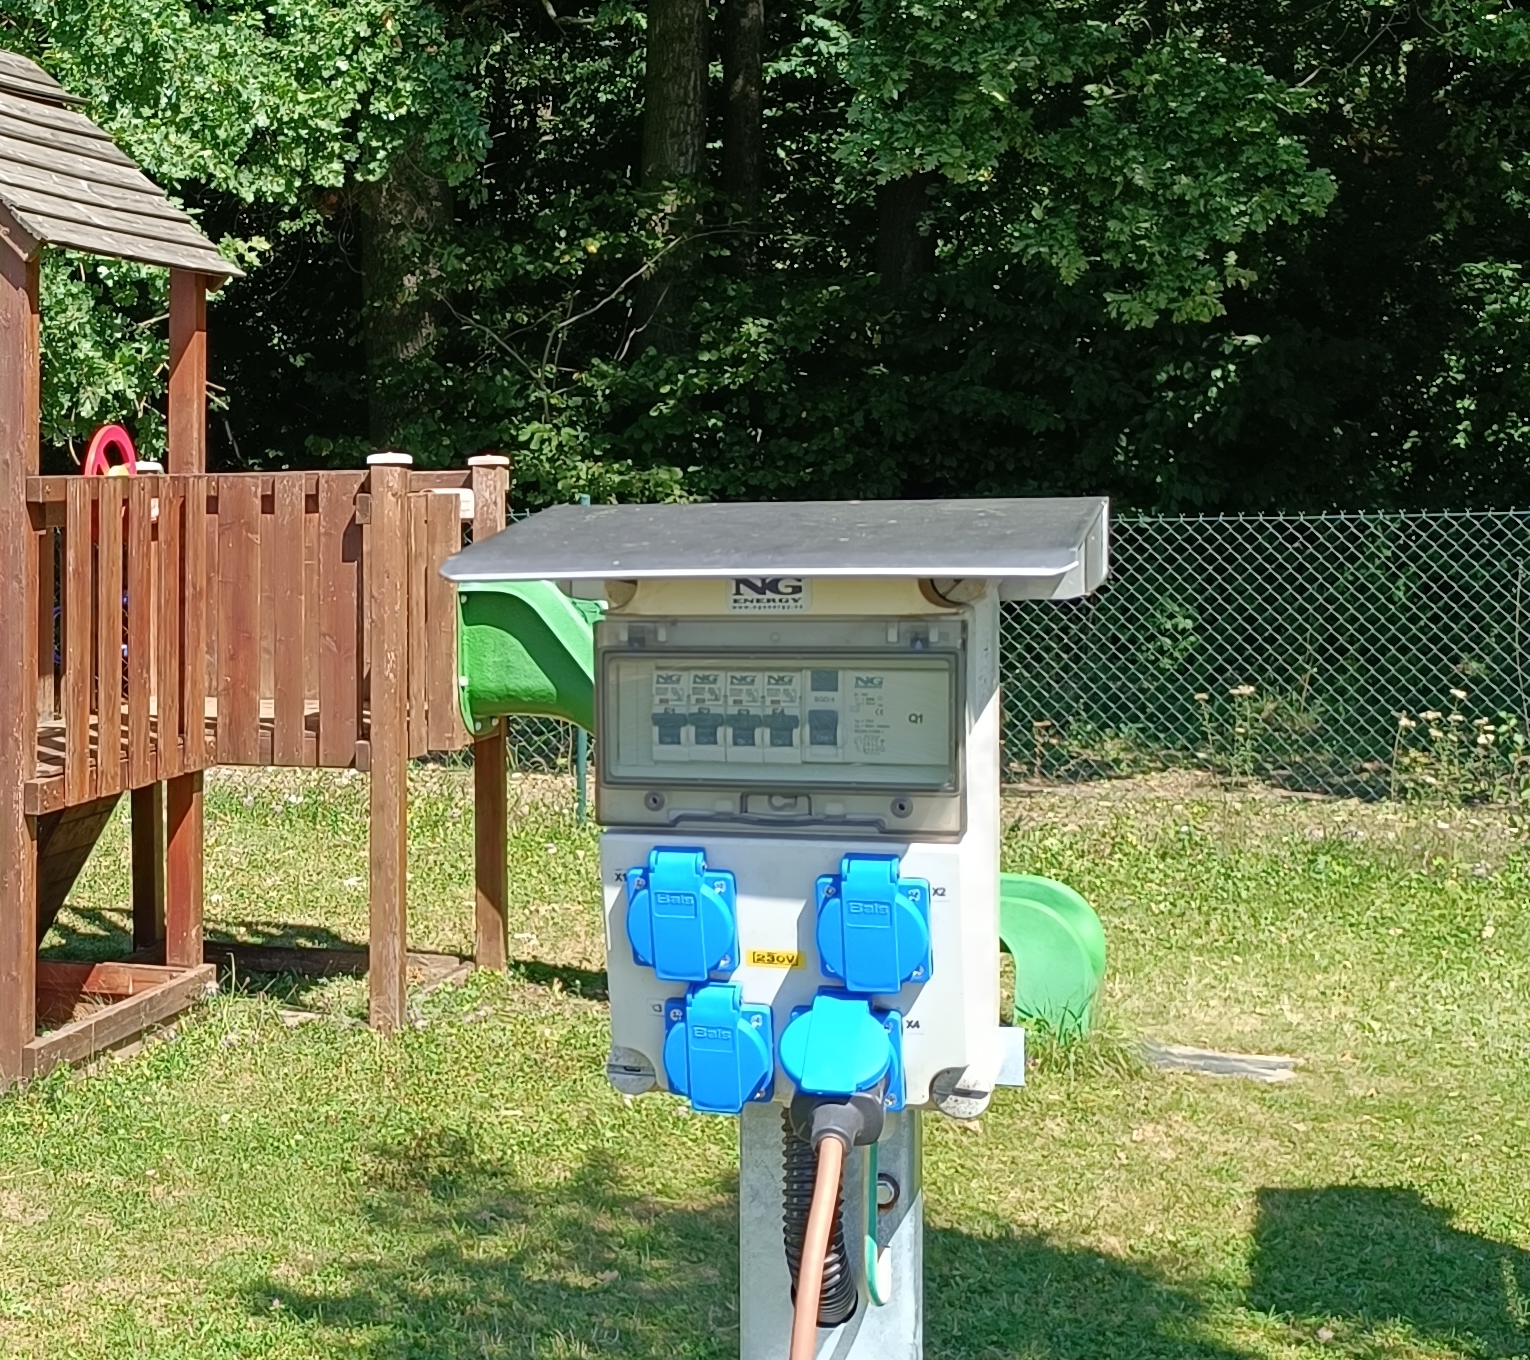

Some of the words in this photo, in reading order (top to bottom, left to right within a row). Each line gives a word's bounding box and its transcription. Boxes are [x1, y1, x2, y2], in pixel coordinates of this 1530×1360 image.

[732, 578, 802, 595] NG
[656, 674, 682, 685] NG
[693, 674, 719, 685] NG
[730, 675, 757, 686] NG
[767, 675, 794, 686] NG
[854, 676, 884, 689] NG
[908, 713, 923, 724] Q1
[932, 888, 946, 897] X2
[657, 893, 695, 905] Bals
[849, 902, 890, 915] Bals
[756, 953, 795, 964] 230V
[906, 1020, 920, 1029] X4
[693, 1026, 732, 1040] Bals
